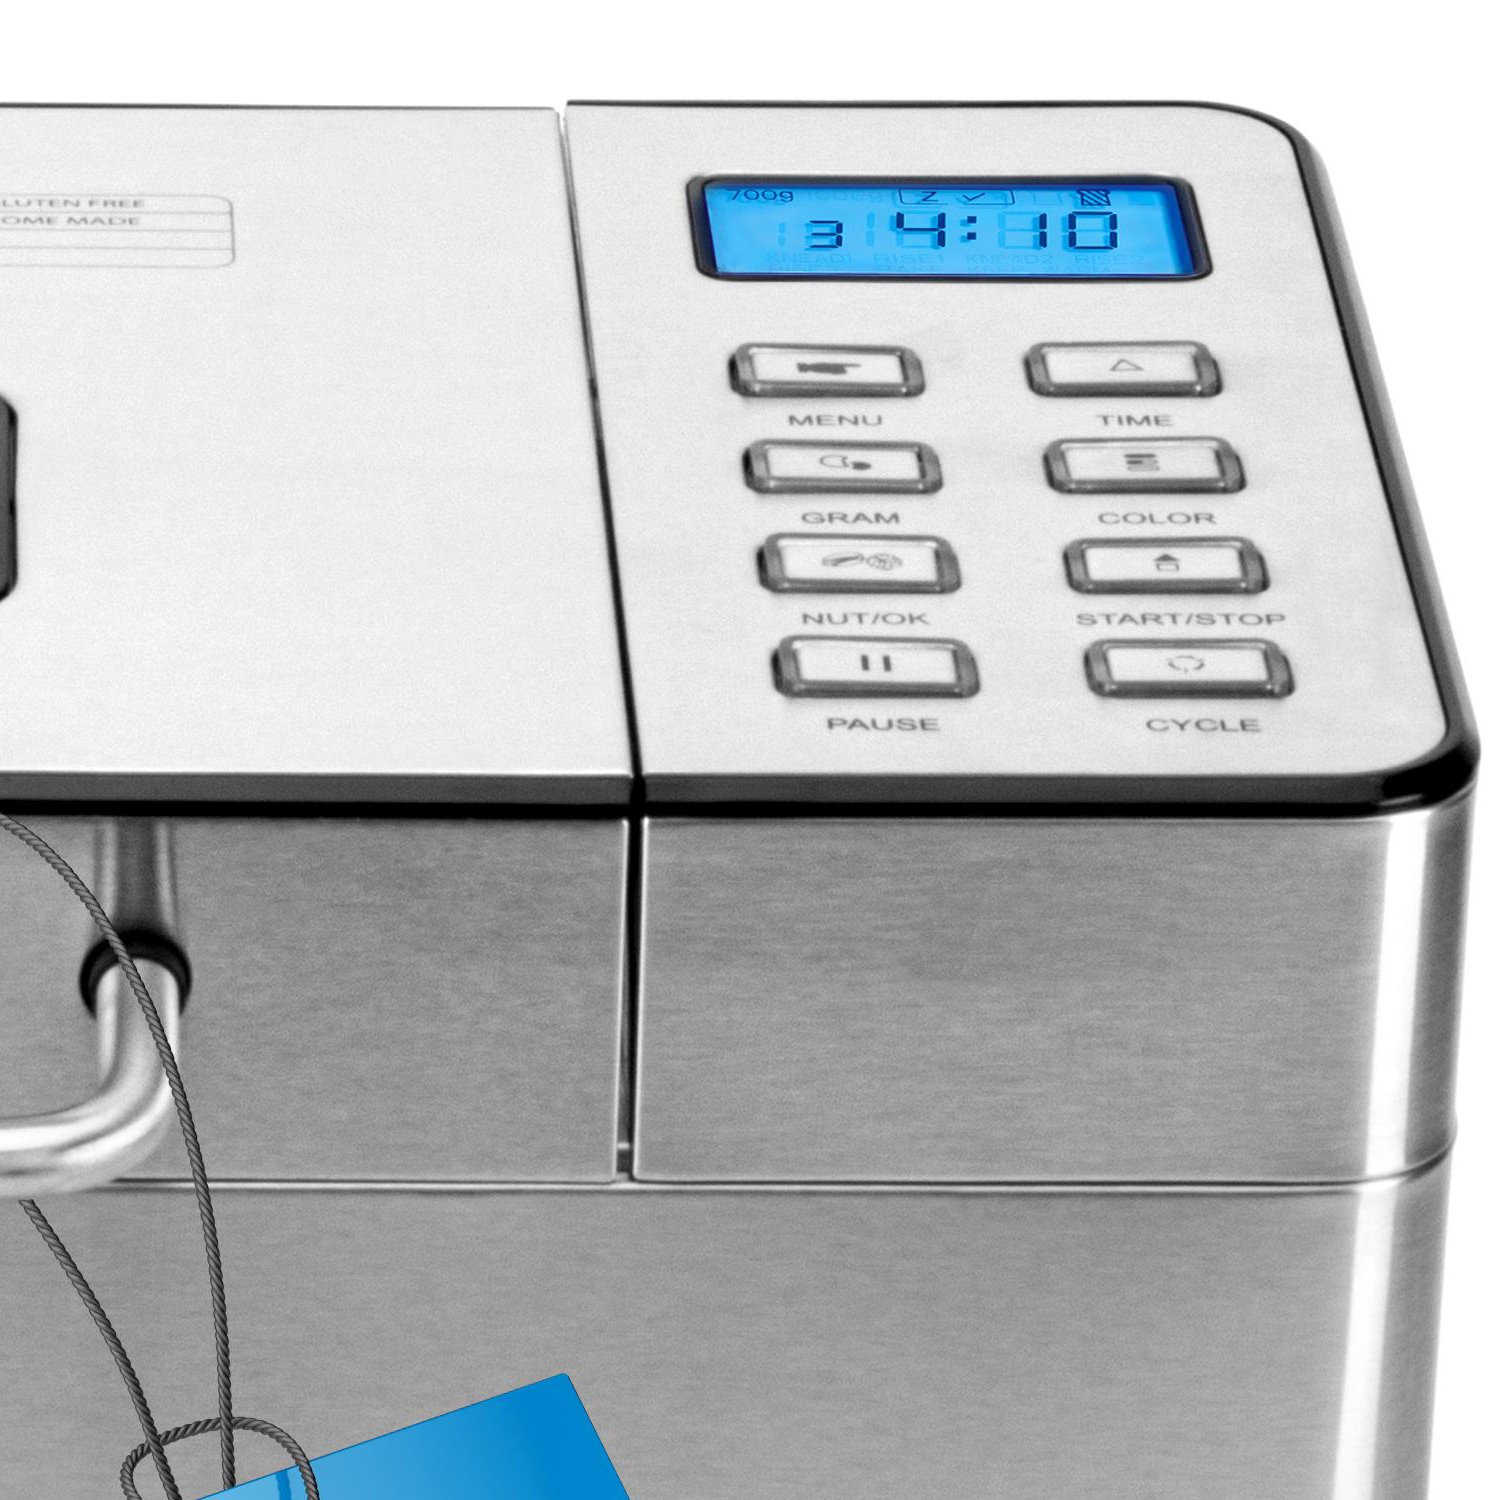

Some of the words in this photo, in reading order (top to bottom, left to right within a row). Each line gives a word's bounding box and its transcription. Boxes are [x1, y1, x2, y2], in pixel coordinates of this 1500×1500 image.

[726, 188, 794, 202] 700g
[87, 198, 146, 209] FREE
[65, 216, 142, 226] MADE
[895, 211, 1118, 251] 4:10
[787, 414, 884, 427] MENU
[1096, 414, 1175, 427] TIME
[800, 511, 901, 525] GRAM
[1097, 511, 1217, 526] COLOR
[801, 612, 931, 626] NUT/OK
[1075, 612, 1287, 627] START/STOP
[826, 717, 942, 732] PAUSE
[1145, 717, 1263, 733] CYCLE
